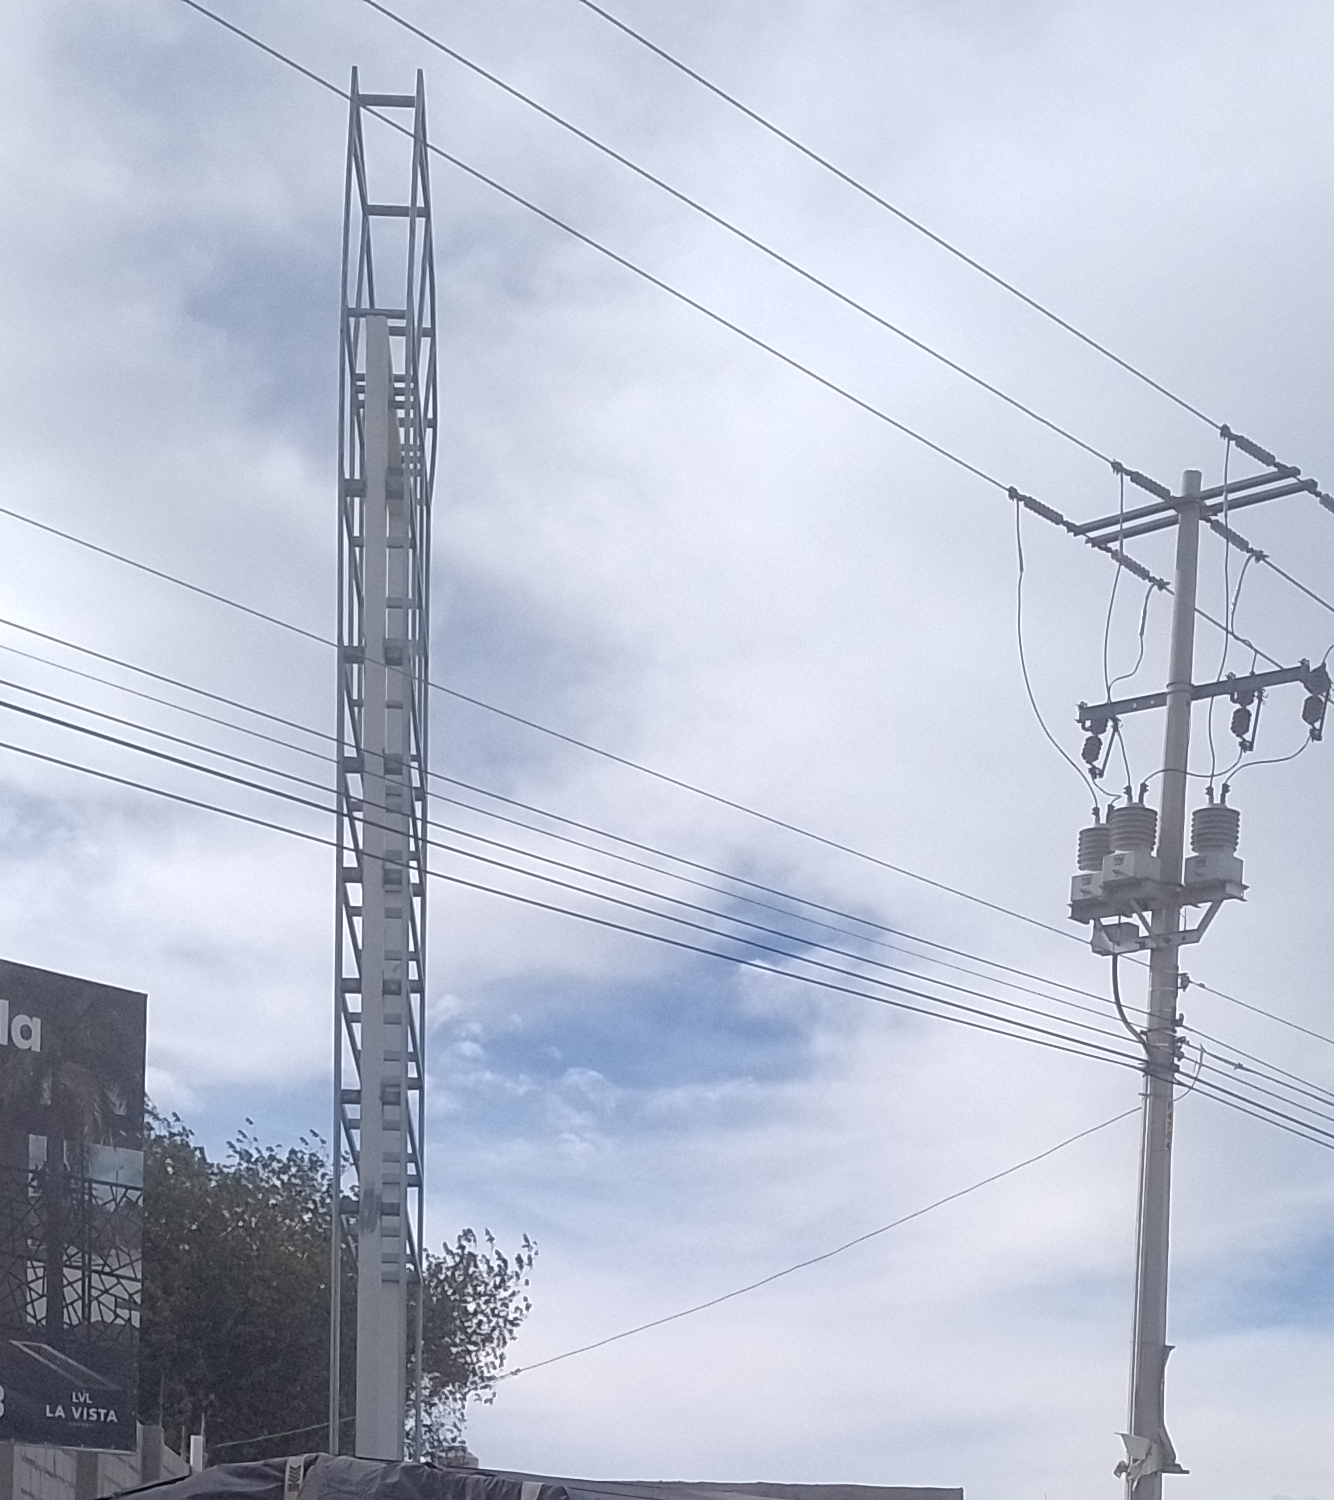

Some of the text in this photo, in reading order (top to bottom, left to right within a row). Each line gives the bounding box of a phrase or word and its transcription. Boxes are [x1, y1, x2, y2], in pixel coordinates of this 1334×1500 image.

[71, 1390, 94, 1404] LVL
[45, 1404, 119, 1423] LA VISTA
